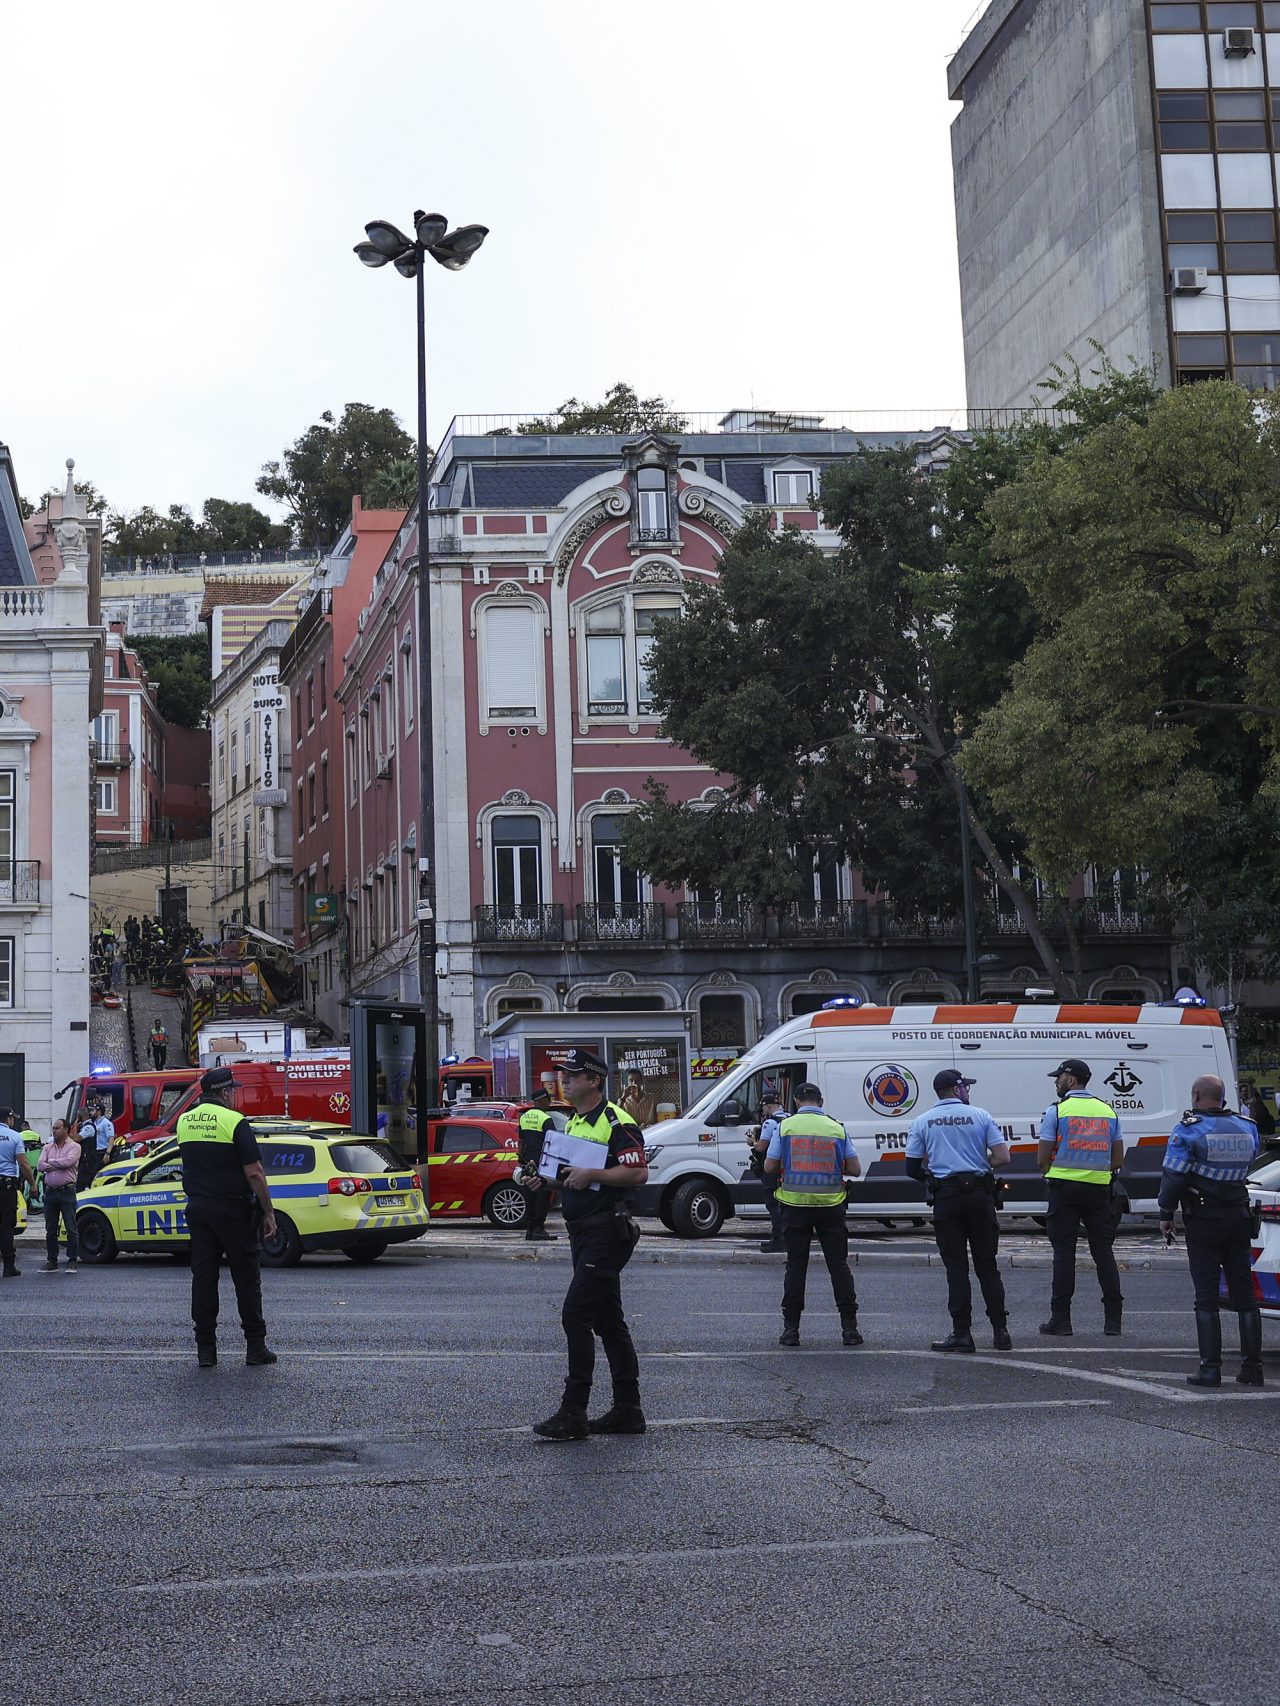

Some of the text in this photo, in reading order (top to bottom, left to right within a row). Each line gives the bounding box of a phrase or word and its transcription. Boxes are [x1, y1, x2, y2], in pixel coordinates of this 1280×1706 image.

[892, 1028, 1135, 1040] POSTO DE COORDENAÇÃO MUNICIPAL MÓVEL
[624, 1051, 635, 1060] SER
[629, 1060, 636, 1069] SE
[288, 1070, 342, 1079] QUELUZ
[643, 1066, 668, 1076] SENTE-SE
[1106, 1100, 1144, 1109] ISBOA
[182, 1112, 217, 1123] POLÍCIA
[928, 1116, 974, 1128] POLÍCIA
[279, 1154, 304, 1166] 112
[618, 1151, 640, 1164] PM
[130, 1193, 167, 1203] EMERGÊNCIA
[136, 1210, 190, 1235] INE
